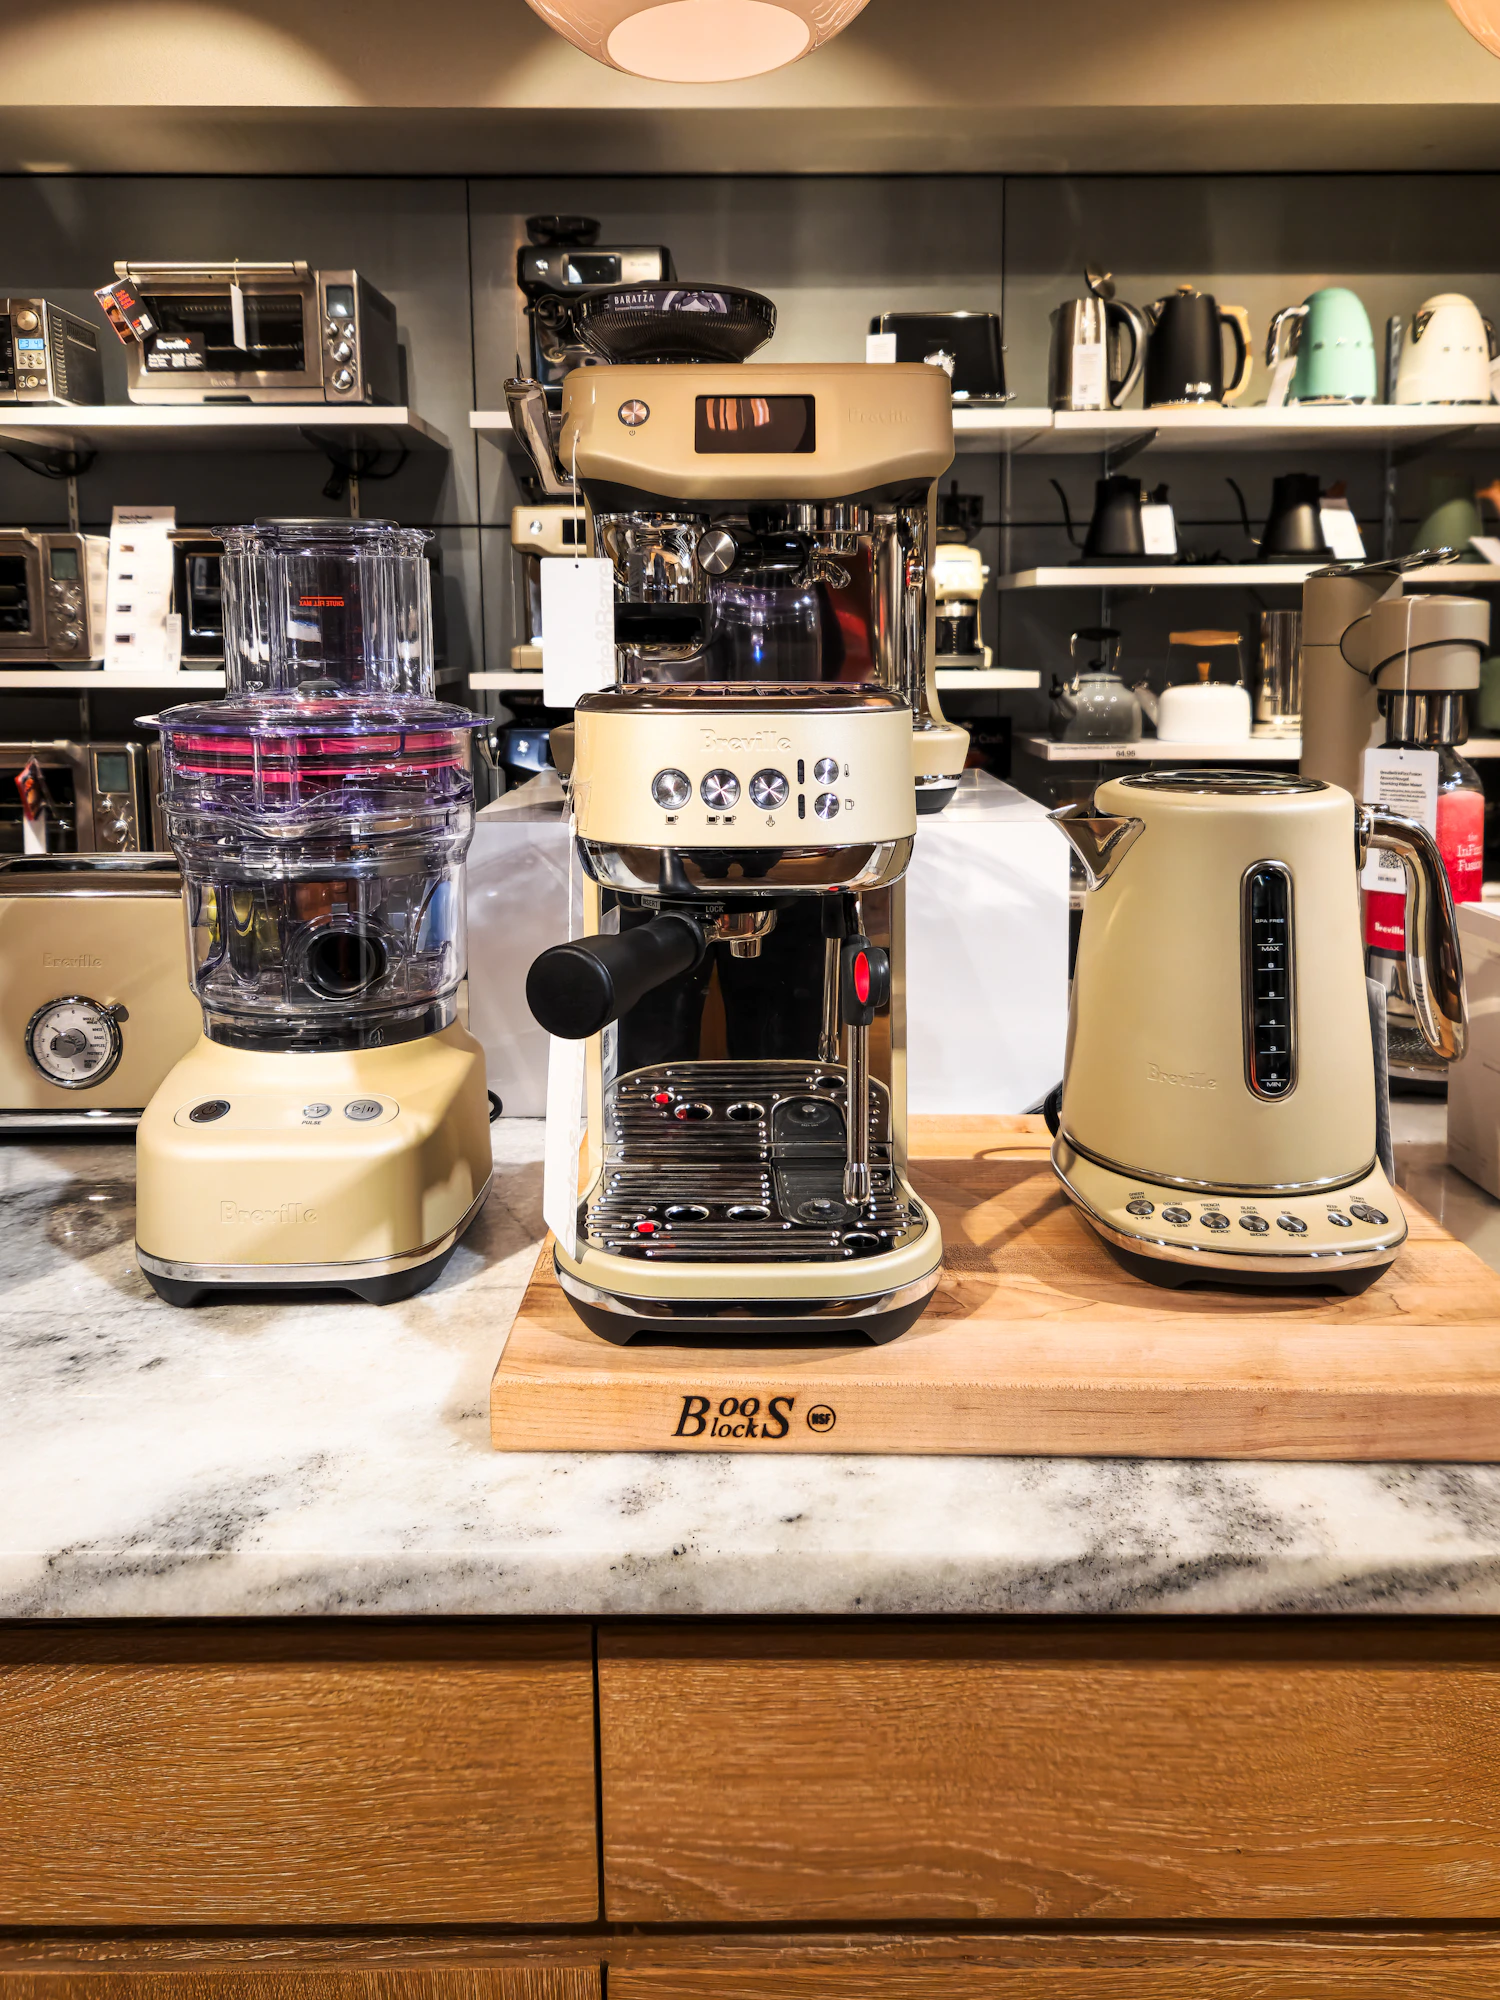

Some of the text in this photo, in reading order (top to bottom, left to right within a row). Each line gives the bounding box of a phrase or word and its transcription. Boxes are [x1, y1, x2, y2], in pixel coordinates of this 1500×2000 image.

[699, 728, 791, 752] Breville
[42, 953, 103, 968] Breville
[1146, 1062, 1218, 1090] Breville
[220, 1201, 317, 1224] Breville
[811, 1413, 831, 1425] NSF
